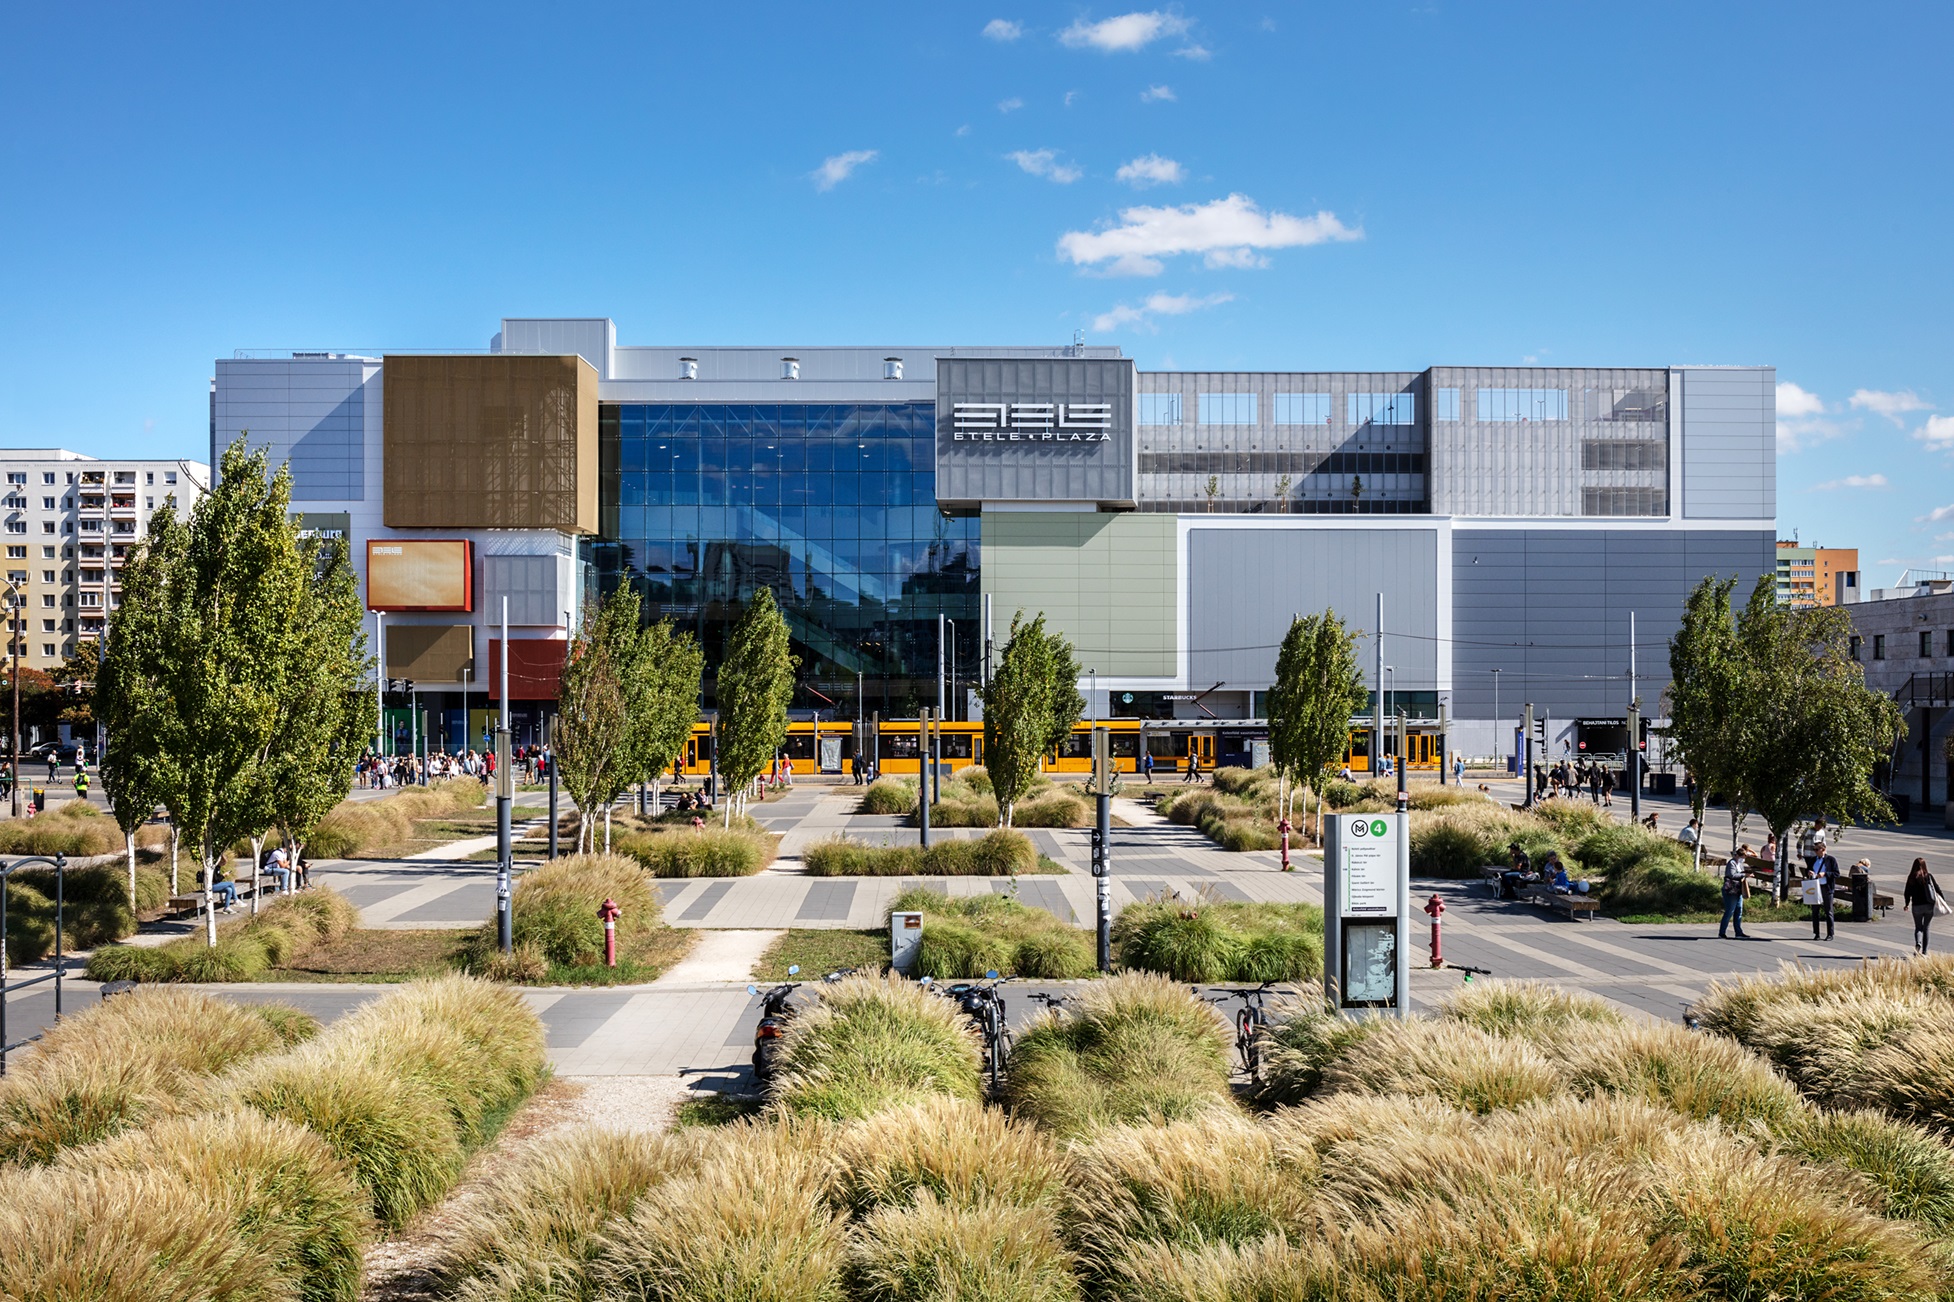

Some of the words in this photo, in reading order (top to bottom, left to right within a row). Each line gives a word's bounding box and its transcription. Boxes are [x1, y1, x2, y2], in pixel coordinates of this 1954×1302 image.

[954, 432, 1020, 441] ETELE
[1042, 432, 1111, 441] PLAZA
[1374, 823, 1383, 834] 4
